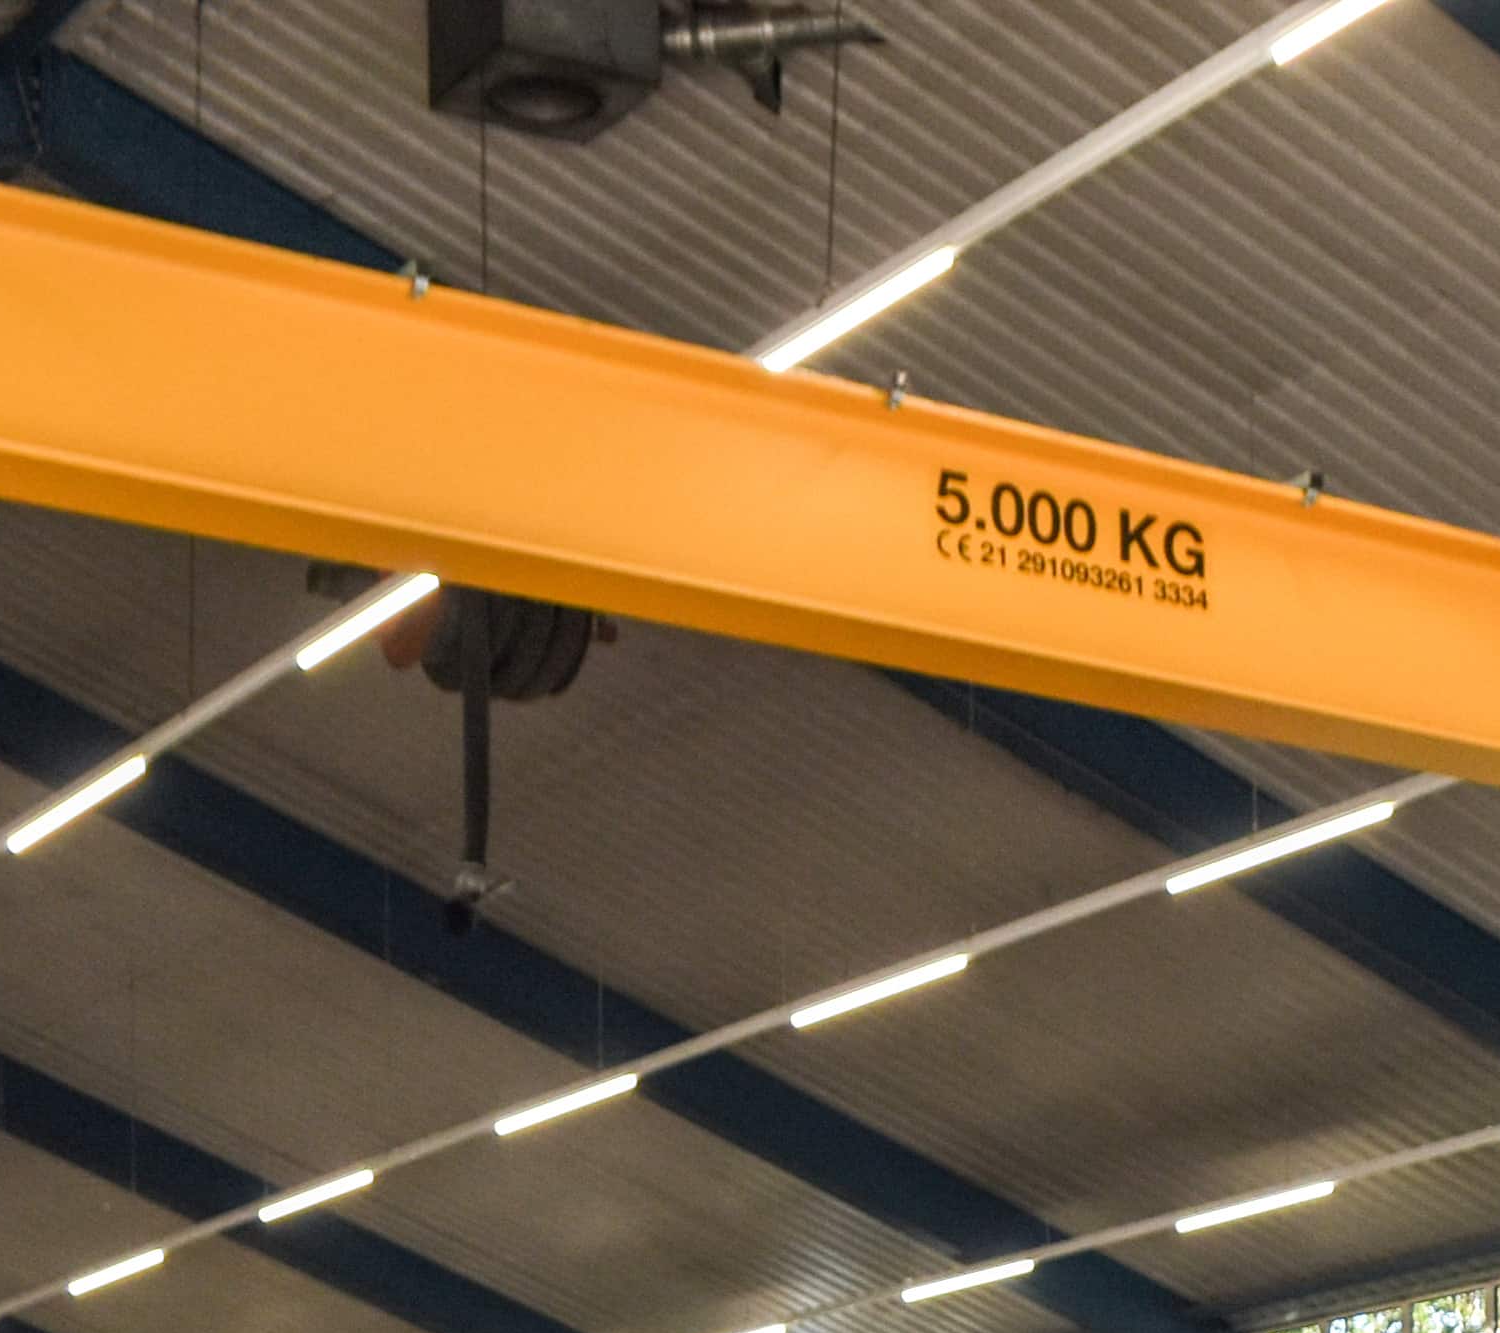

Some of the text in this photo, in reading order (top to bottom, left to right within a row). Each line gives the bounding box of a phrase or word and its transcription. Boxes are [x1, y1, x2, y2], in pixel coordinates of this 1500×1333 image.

[935, 468, 1206, 578] 5.000 KG
[980, 541, 1007, 568] 21
[1017, 549, 1143, 597] 291093261
[1154, 578, 1208, 610] 3334
